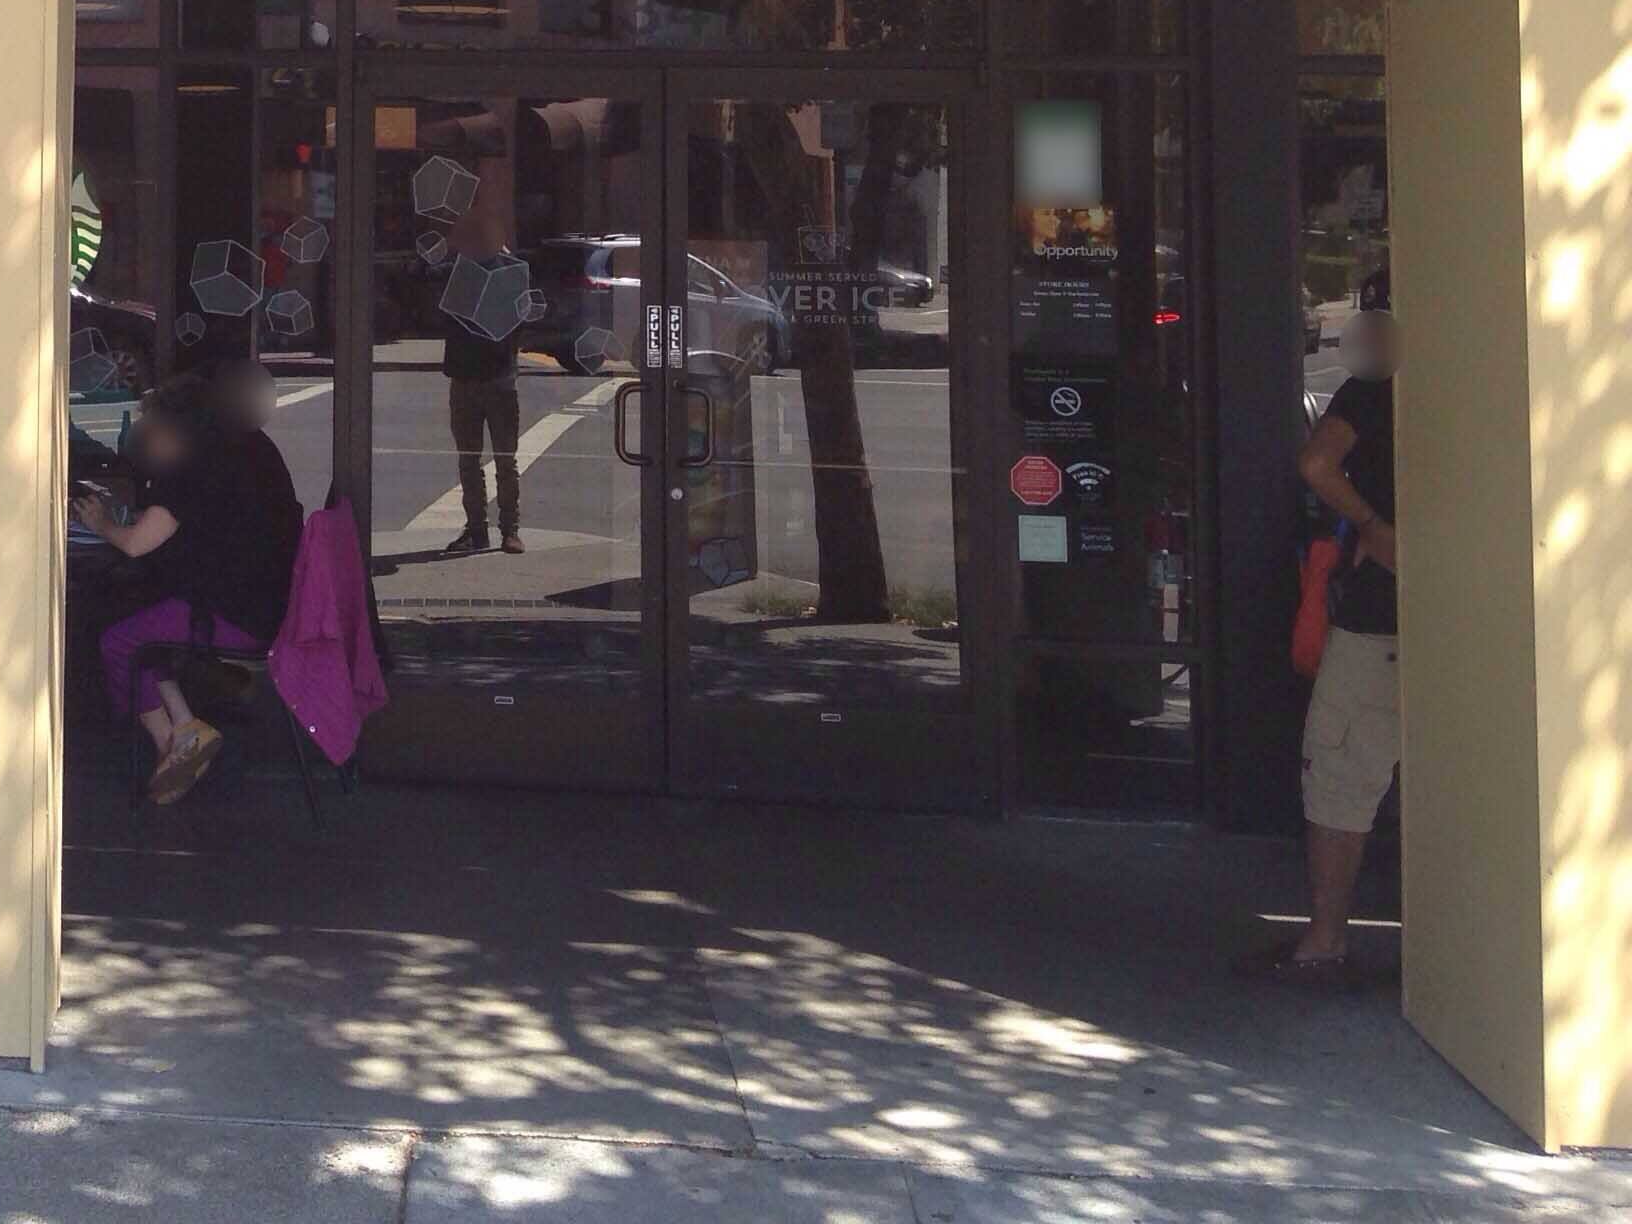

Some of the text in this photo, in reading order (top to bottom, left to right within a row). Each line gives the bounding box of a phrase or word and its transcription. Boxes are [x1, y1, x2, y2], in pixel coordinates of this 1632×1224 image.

[768, 271, 822, 281] SUMMER
[852, 286, 905, 312] ICE
[649, 313, 659, 349] PULL
[670, 313, 680, 349] PULL
